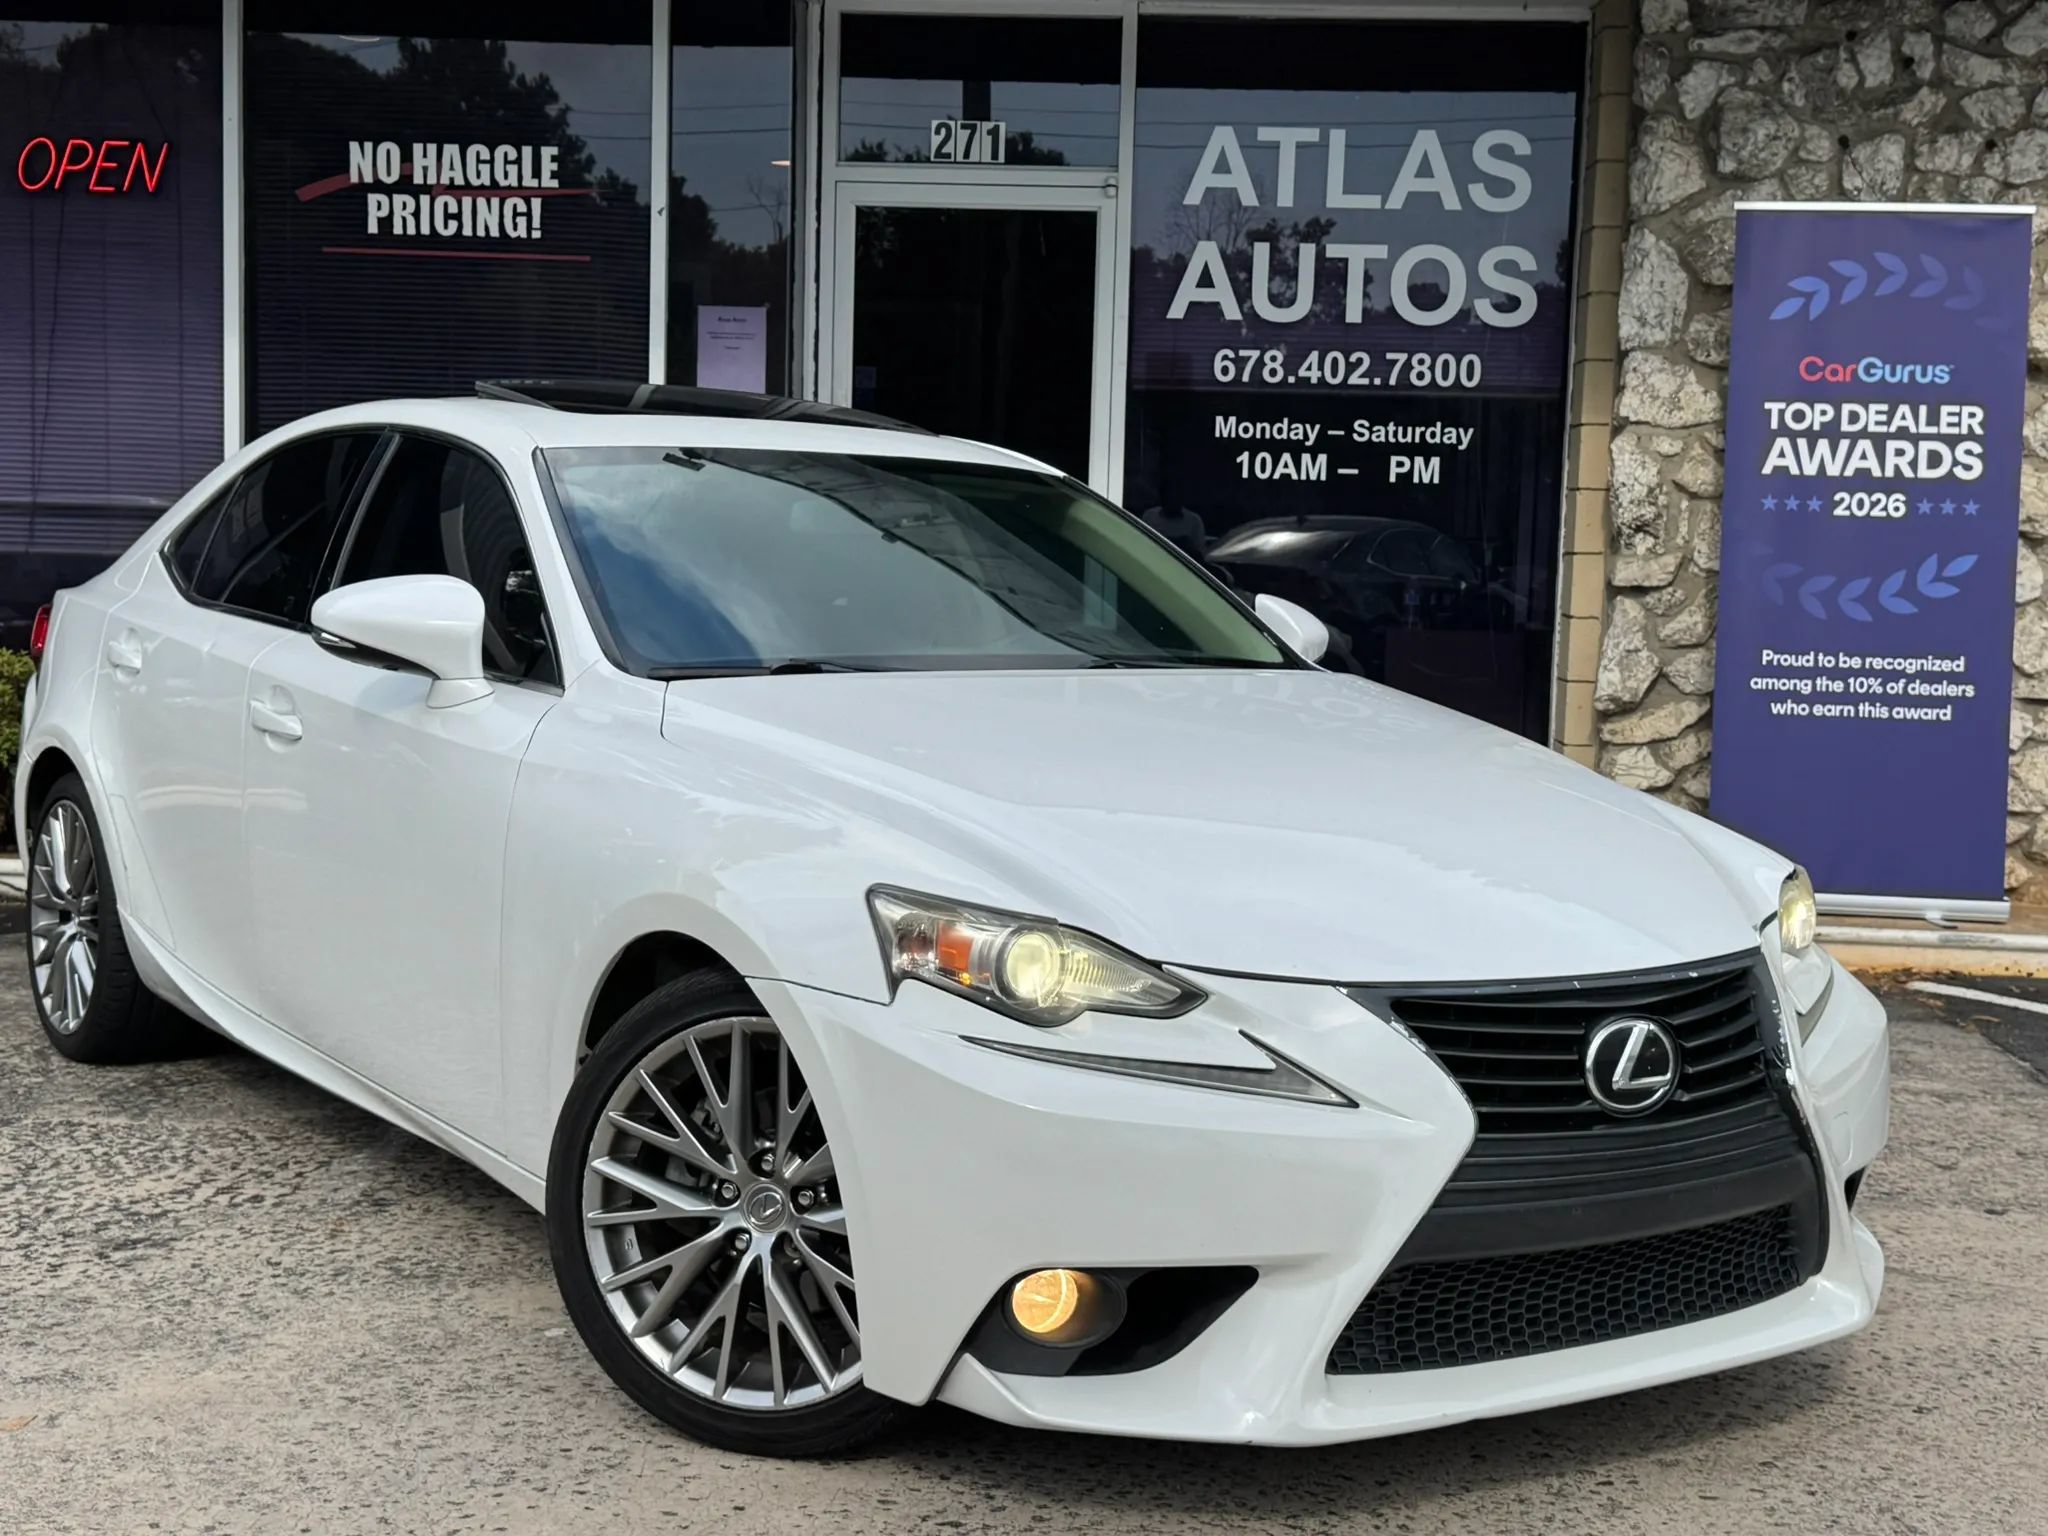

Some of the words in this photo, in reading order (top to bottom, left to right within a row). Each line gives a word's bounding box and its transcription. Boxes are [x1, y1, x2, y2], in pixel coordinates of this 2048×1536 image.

[933, 121, 1003, 161] 271
[17, 137, 169, 193] OPEN
[348, 141, 401, 185] NO
[412, 142, 560, 188] HAGGLE
[1183, 125, 1532, 213] ATLAS
[366, 192, 543, 239] PRICING!
[1166, 240, 1538, 329] AUTOS
[1213, 348, 1482, 388] 678.402.7800
[1798, 356, 1952, 385] CarGurus
[1214, 415, 1321, 447] Monday
[1352, 419, 1475, 450] Saturday
[1763, 401, 1835, 431] TOP
[1840, 403, 1984, 435] DEALER
[1235, 451, 1328, 482] 10AM
[1388, 455, 1441, 484] PM
[1761, 436, 1984, 481] AWARDS
[1832, 491, 1907, 518] 2026
[1761, 649, 1815, 668] Proud
[1817, 652, 1836, 668] to
[1838, 652, 1863, 669] be
[1865, 655, 1965, 674] recognized
[1749, 676, 1813, 695] among
[1815, 676, 1845, 693] the
[1847, 676, 1884, 694] 10%
[1886, 678, 1907, 695] of
[1907, 678, 1976, 698] dealers
[1770, 698, 1810, 716] who
[1812, 703, 1855, 718] earn
[1857, 701, 1890, 719] this
[1891, 703, 1952, 721] award
